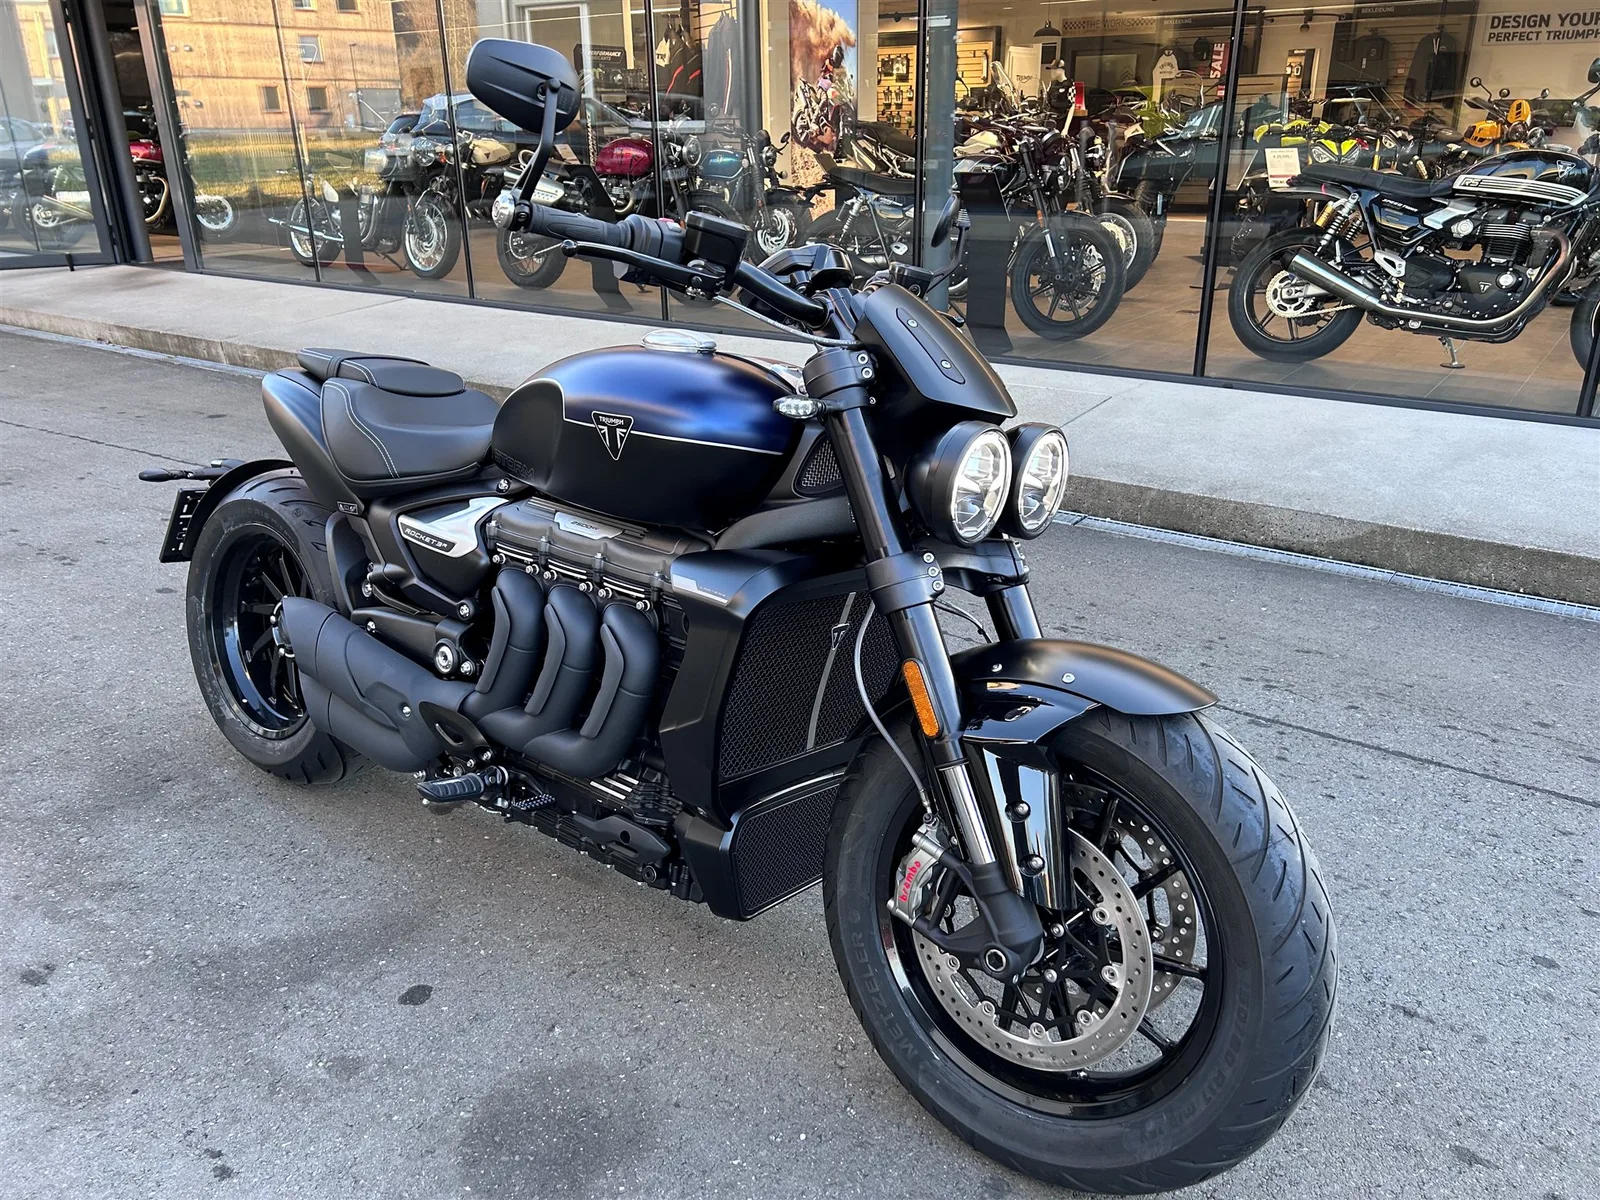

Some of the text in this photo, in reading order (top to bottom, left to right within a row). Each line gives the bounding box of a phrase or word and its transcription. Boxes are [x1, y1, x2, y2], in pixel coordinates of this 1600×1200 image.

[1086, 18, 1132, 29] THE WORKS
[1490, 14, 1551, 29] DESIGN
[1488, 31, 1541, 42] PERFECT
[1210, 43, 1225, 78] SALE
[1461, 177, 1480, 187] RS
[599, 416, 624, 426] TRIUMPH
[492, 448, 535, 482] STORM
[898, 860, 921, 903] brembo
[851, 931, 919, 1061] METZELER
